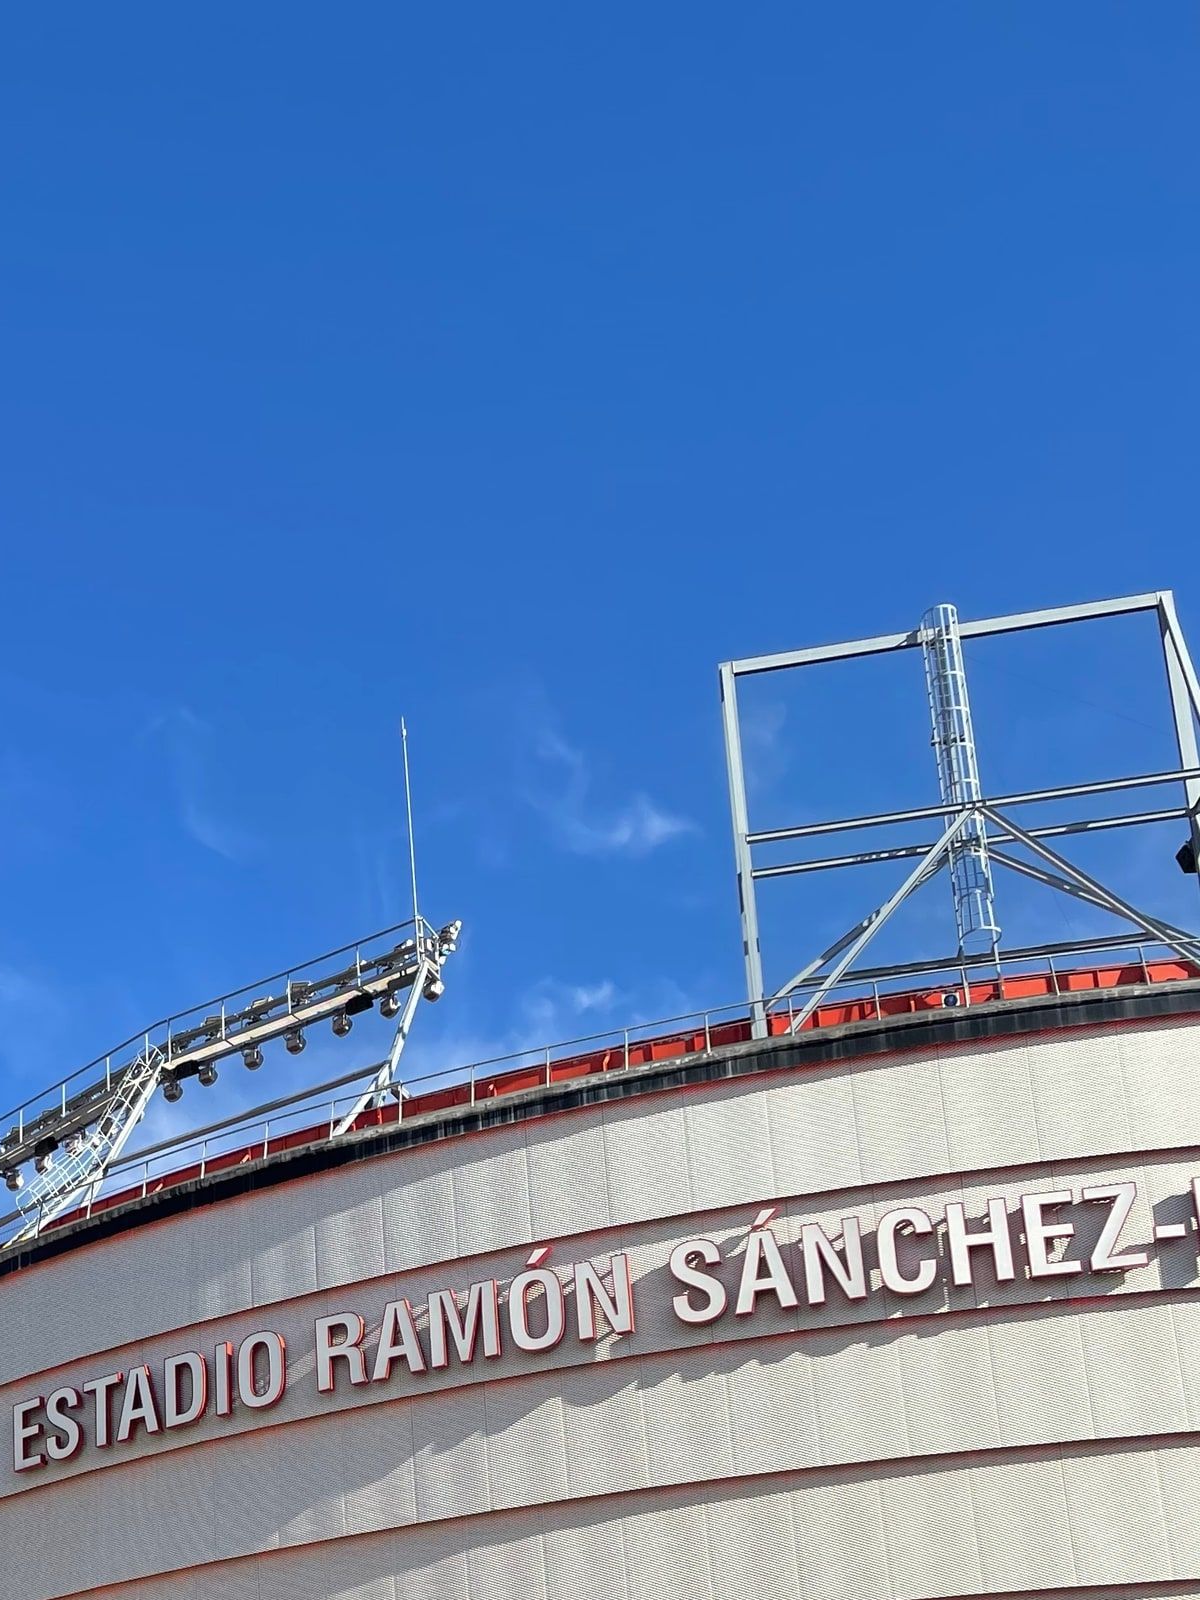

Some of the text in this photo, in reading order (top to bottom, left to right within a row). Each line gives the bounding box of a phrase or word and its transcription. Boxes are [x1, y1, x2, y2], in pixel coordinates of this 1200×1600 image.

[13, 1176, 1200, 1473] ESTADIO RAMÓN SÁNCHEZ-
